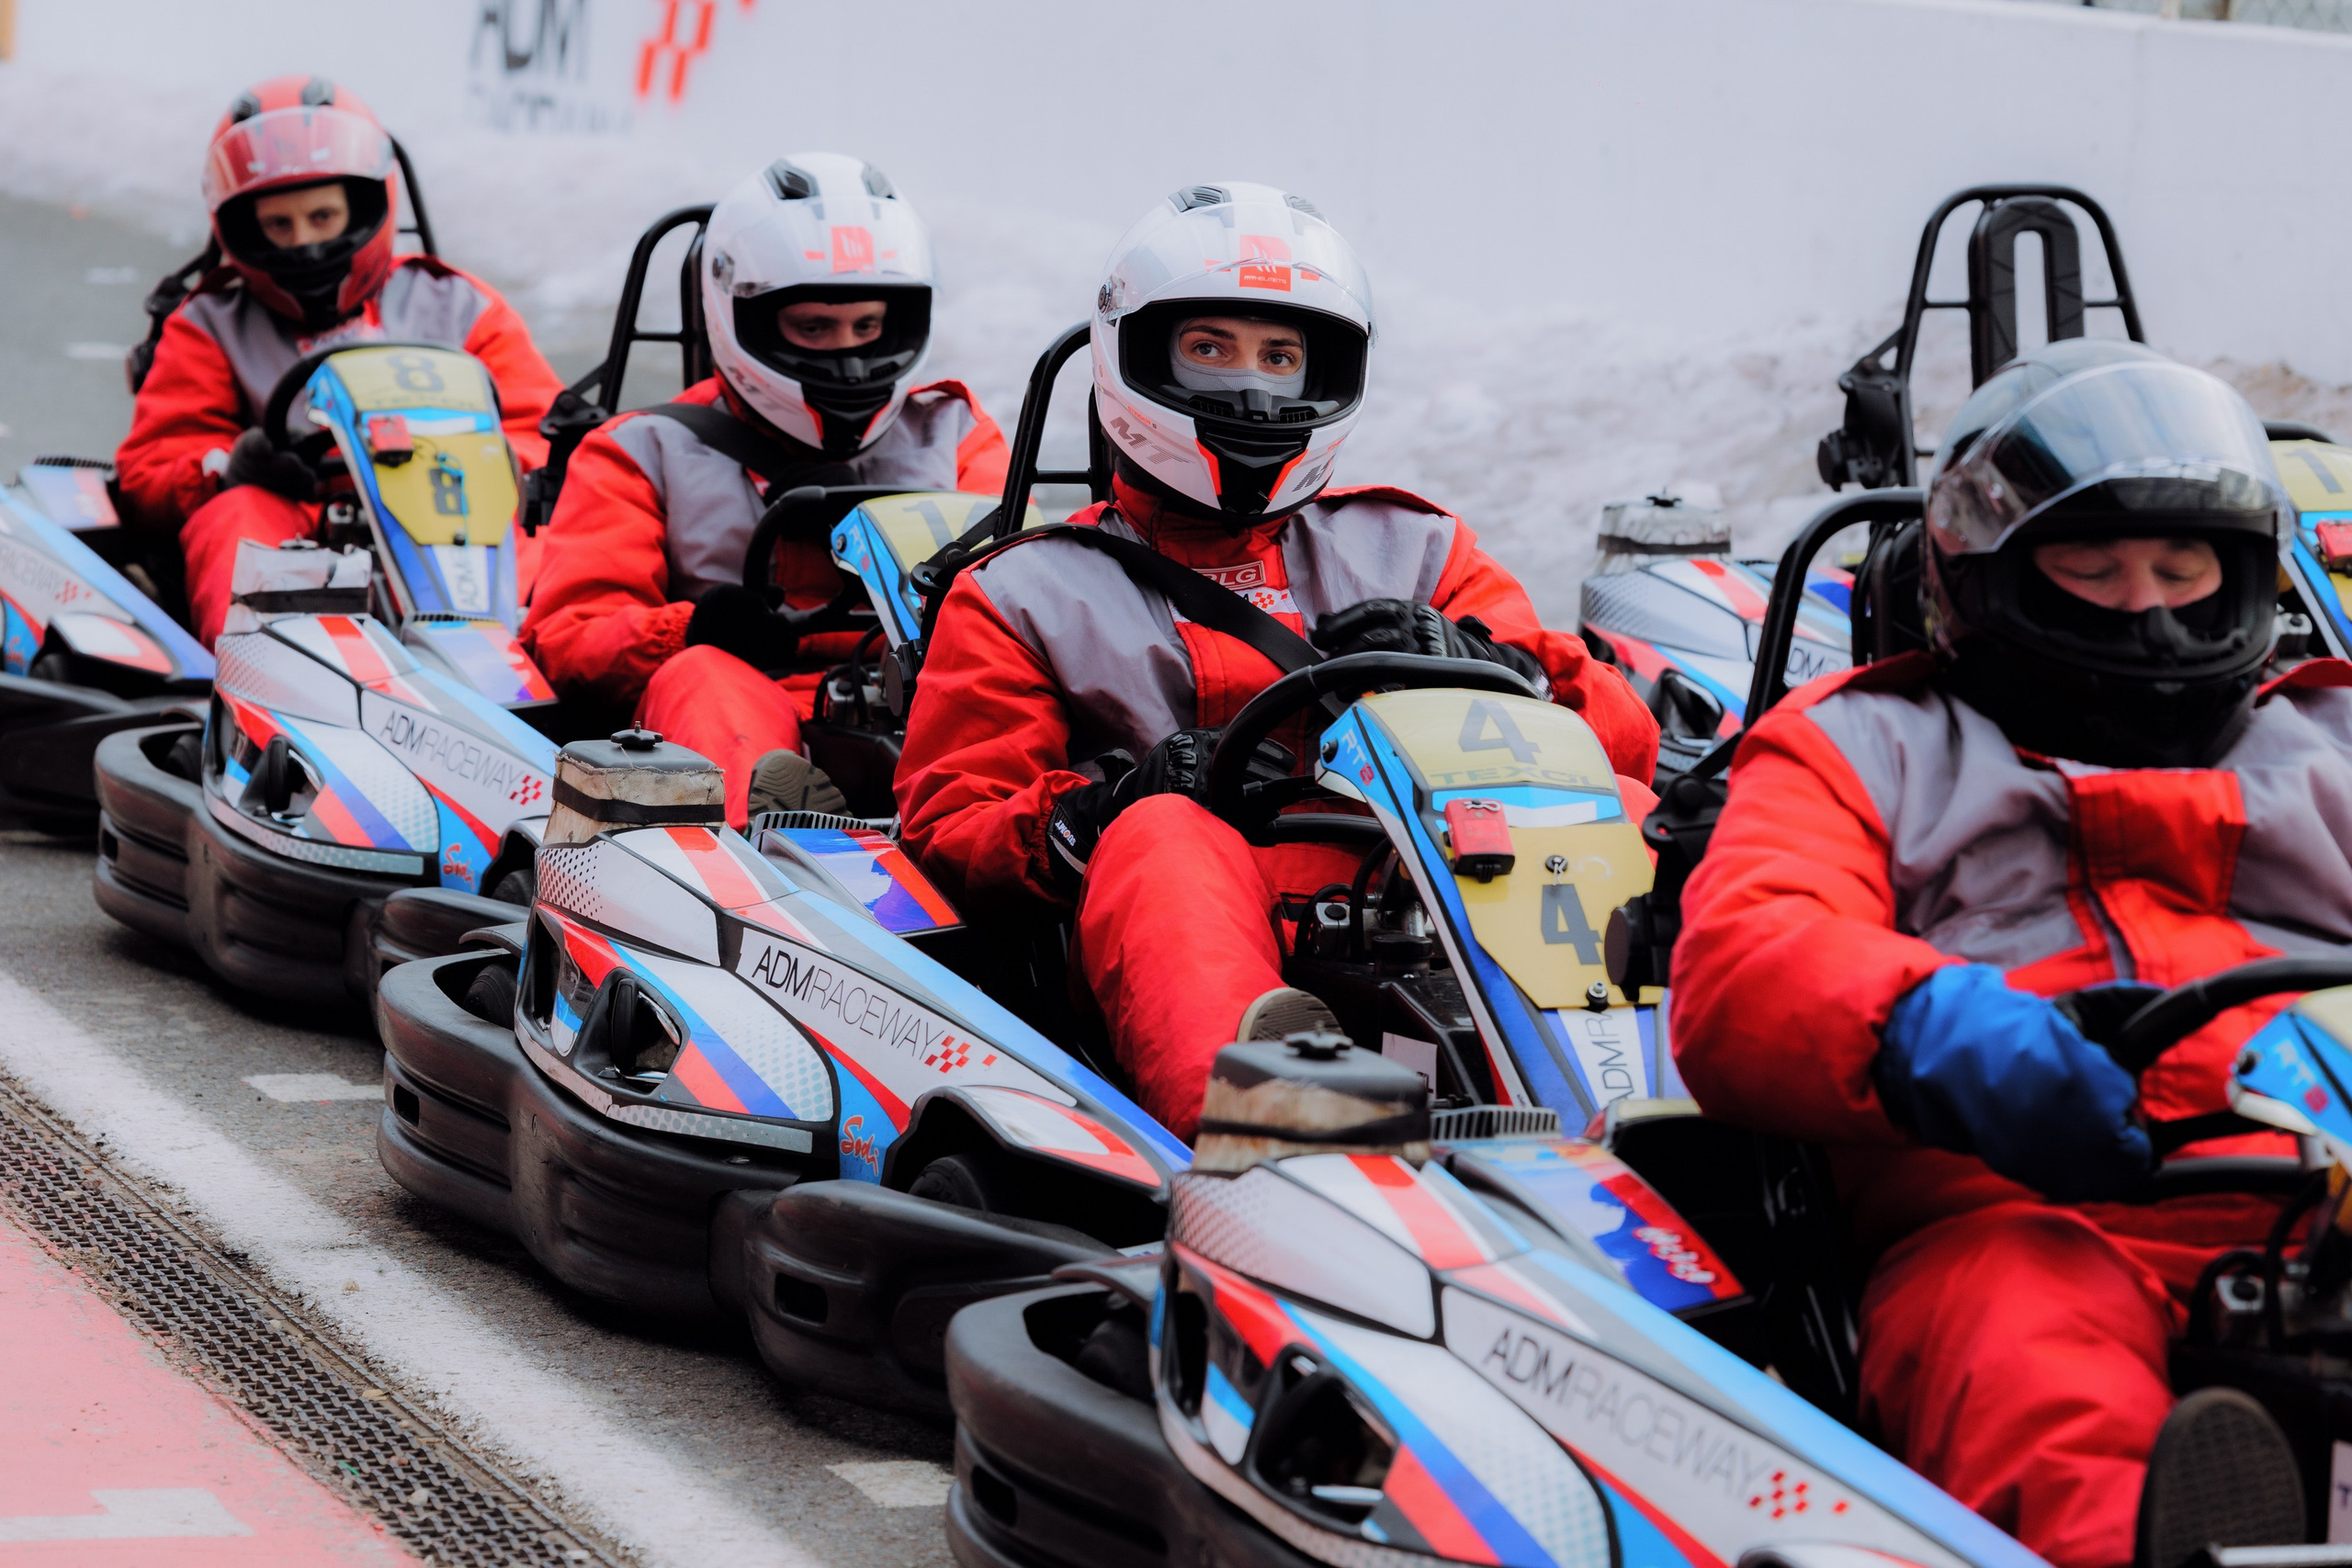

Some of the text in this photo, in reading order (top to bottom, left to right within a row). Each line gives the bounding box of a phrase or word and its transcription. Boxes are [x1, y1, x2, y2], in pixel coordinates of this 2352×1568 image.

[387, 352, 446, 393] 8
[1109, 416, 1196, 465] MT
[428, 468, 469, 515] 8
[379, 709, 526, 797] ADMRACEWAY
[1457, 699, 1543, 765] 4
[1054, 819, 1077, 847] SUOMY
[1540, 883, 1602, 965] 4
[751, 944, 945, 1061] ADMRACEWAY
[1481, 1326, 1770, 1501] ADMRACEWAY
